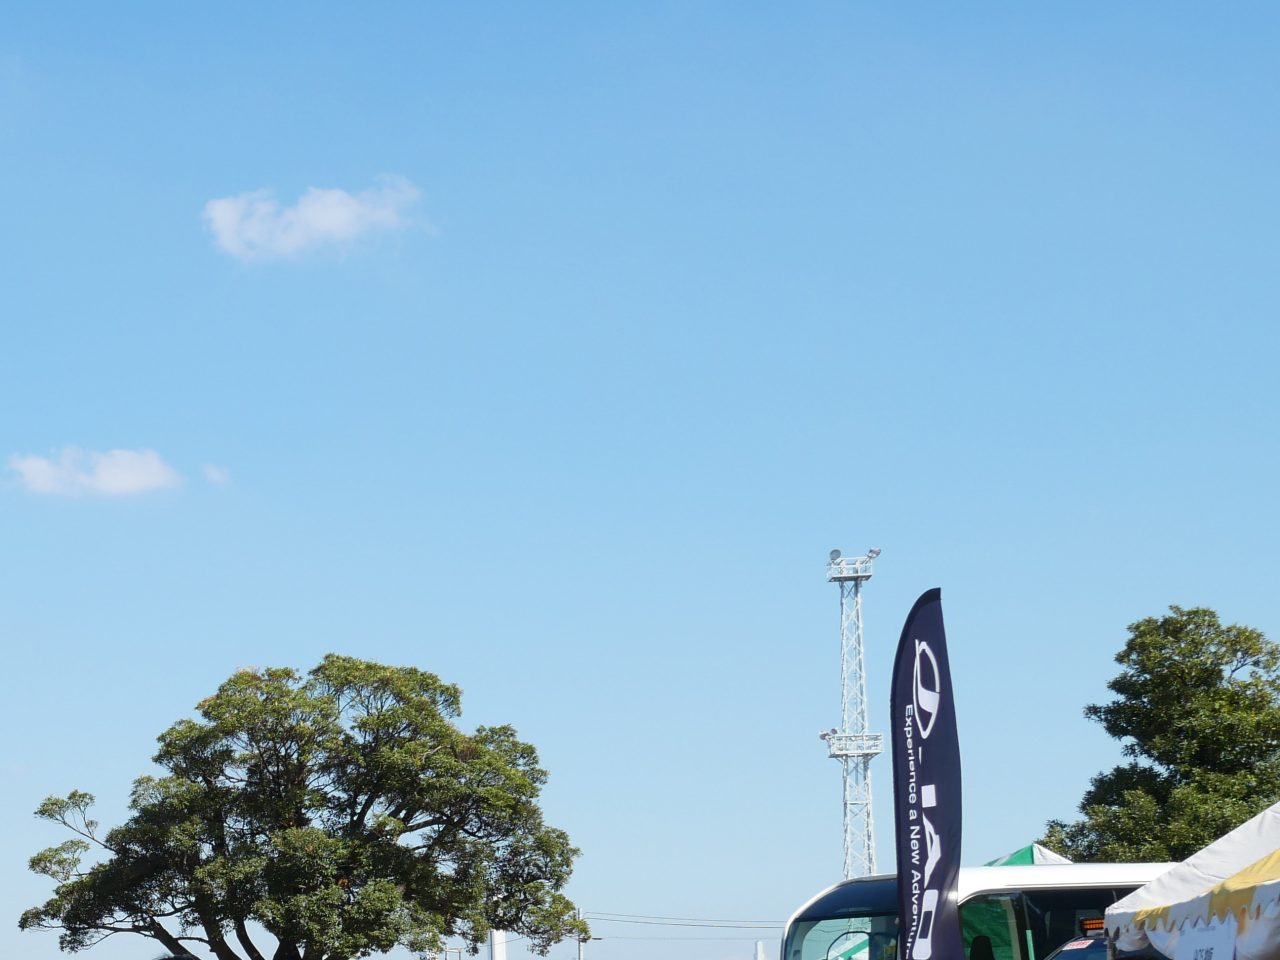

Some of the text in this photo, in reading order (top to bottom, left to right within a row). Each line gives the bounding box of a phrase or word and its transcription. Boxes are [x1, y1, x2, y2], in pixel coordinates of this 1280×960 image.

[904, 704, 917, 804] Experience
[909, 809, 918, 820] a
[910, 826, 920, 865] New
